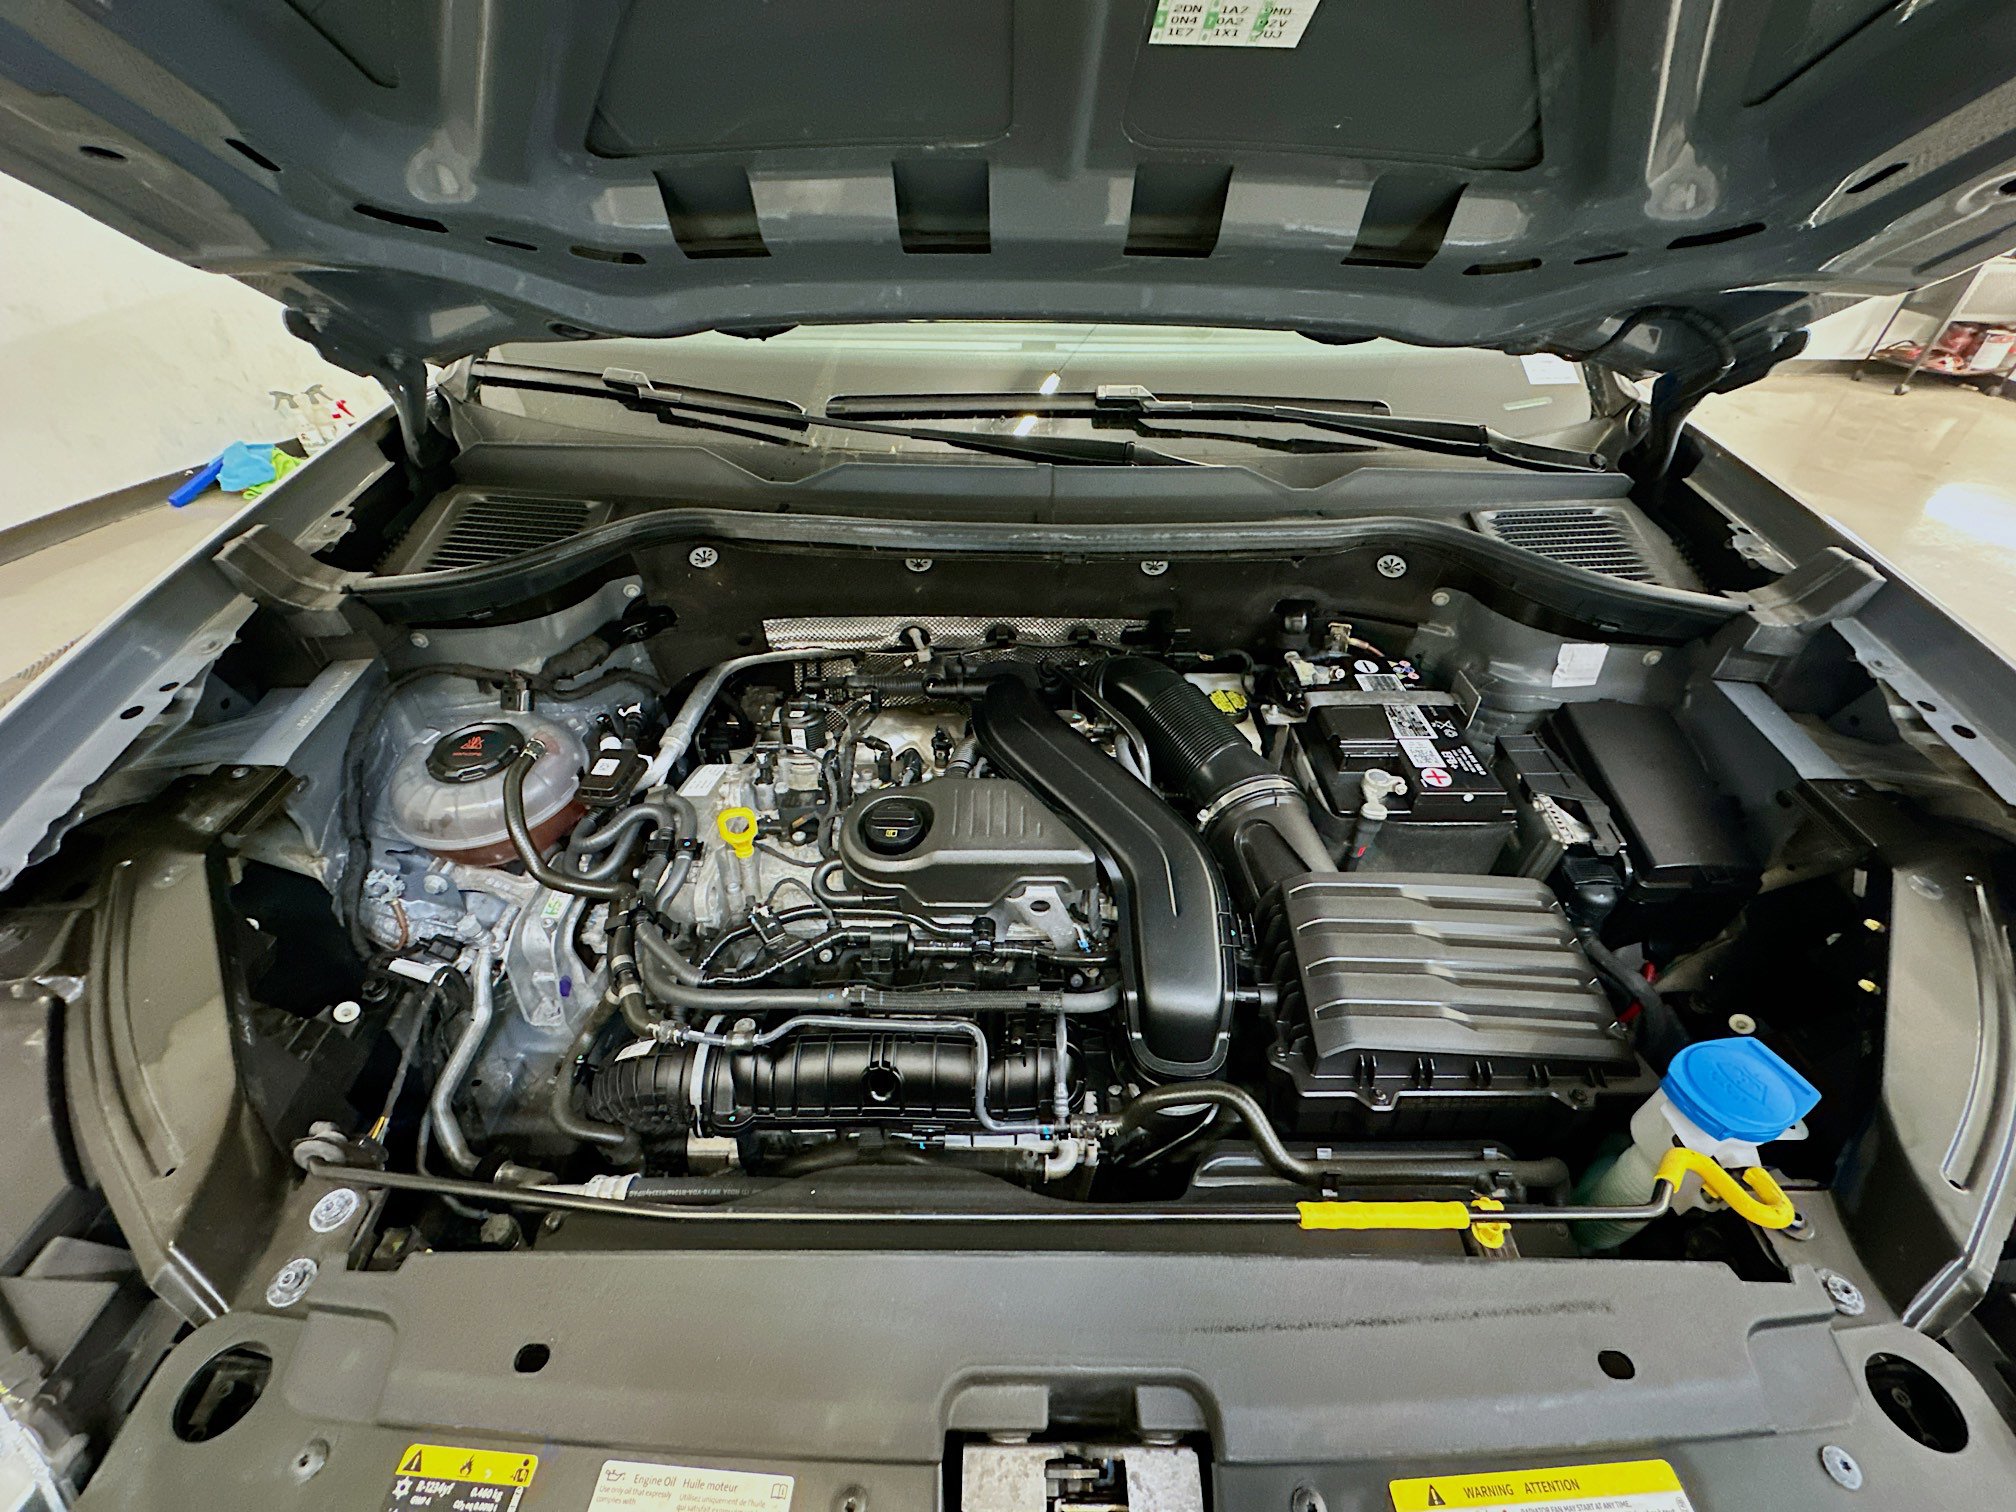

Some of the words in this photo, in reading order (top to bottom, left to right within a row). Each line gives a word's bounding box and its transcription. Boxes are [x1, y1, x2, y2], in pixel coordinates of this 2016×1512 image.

[1167, 27, 1194, 36] 1E7
[633, 1474, 662, 1488] Engine
[663, 1476, 677, 1488] Oil
[682, 1477, 706, 1490] Huile
[706, 1482, 739, 1492] moteur
[1463, 1483, 1514, 1499] WARNING
[1524, 1478, 1580, 1494] ATTENTION
[1576, 1502, 1595, 1511] START
[1594, 1502, 1603, 1510] AT
[1603, 1501, 1616, 1509] ANY
